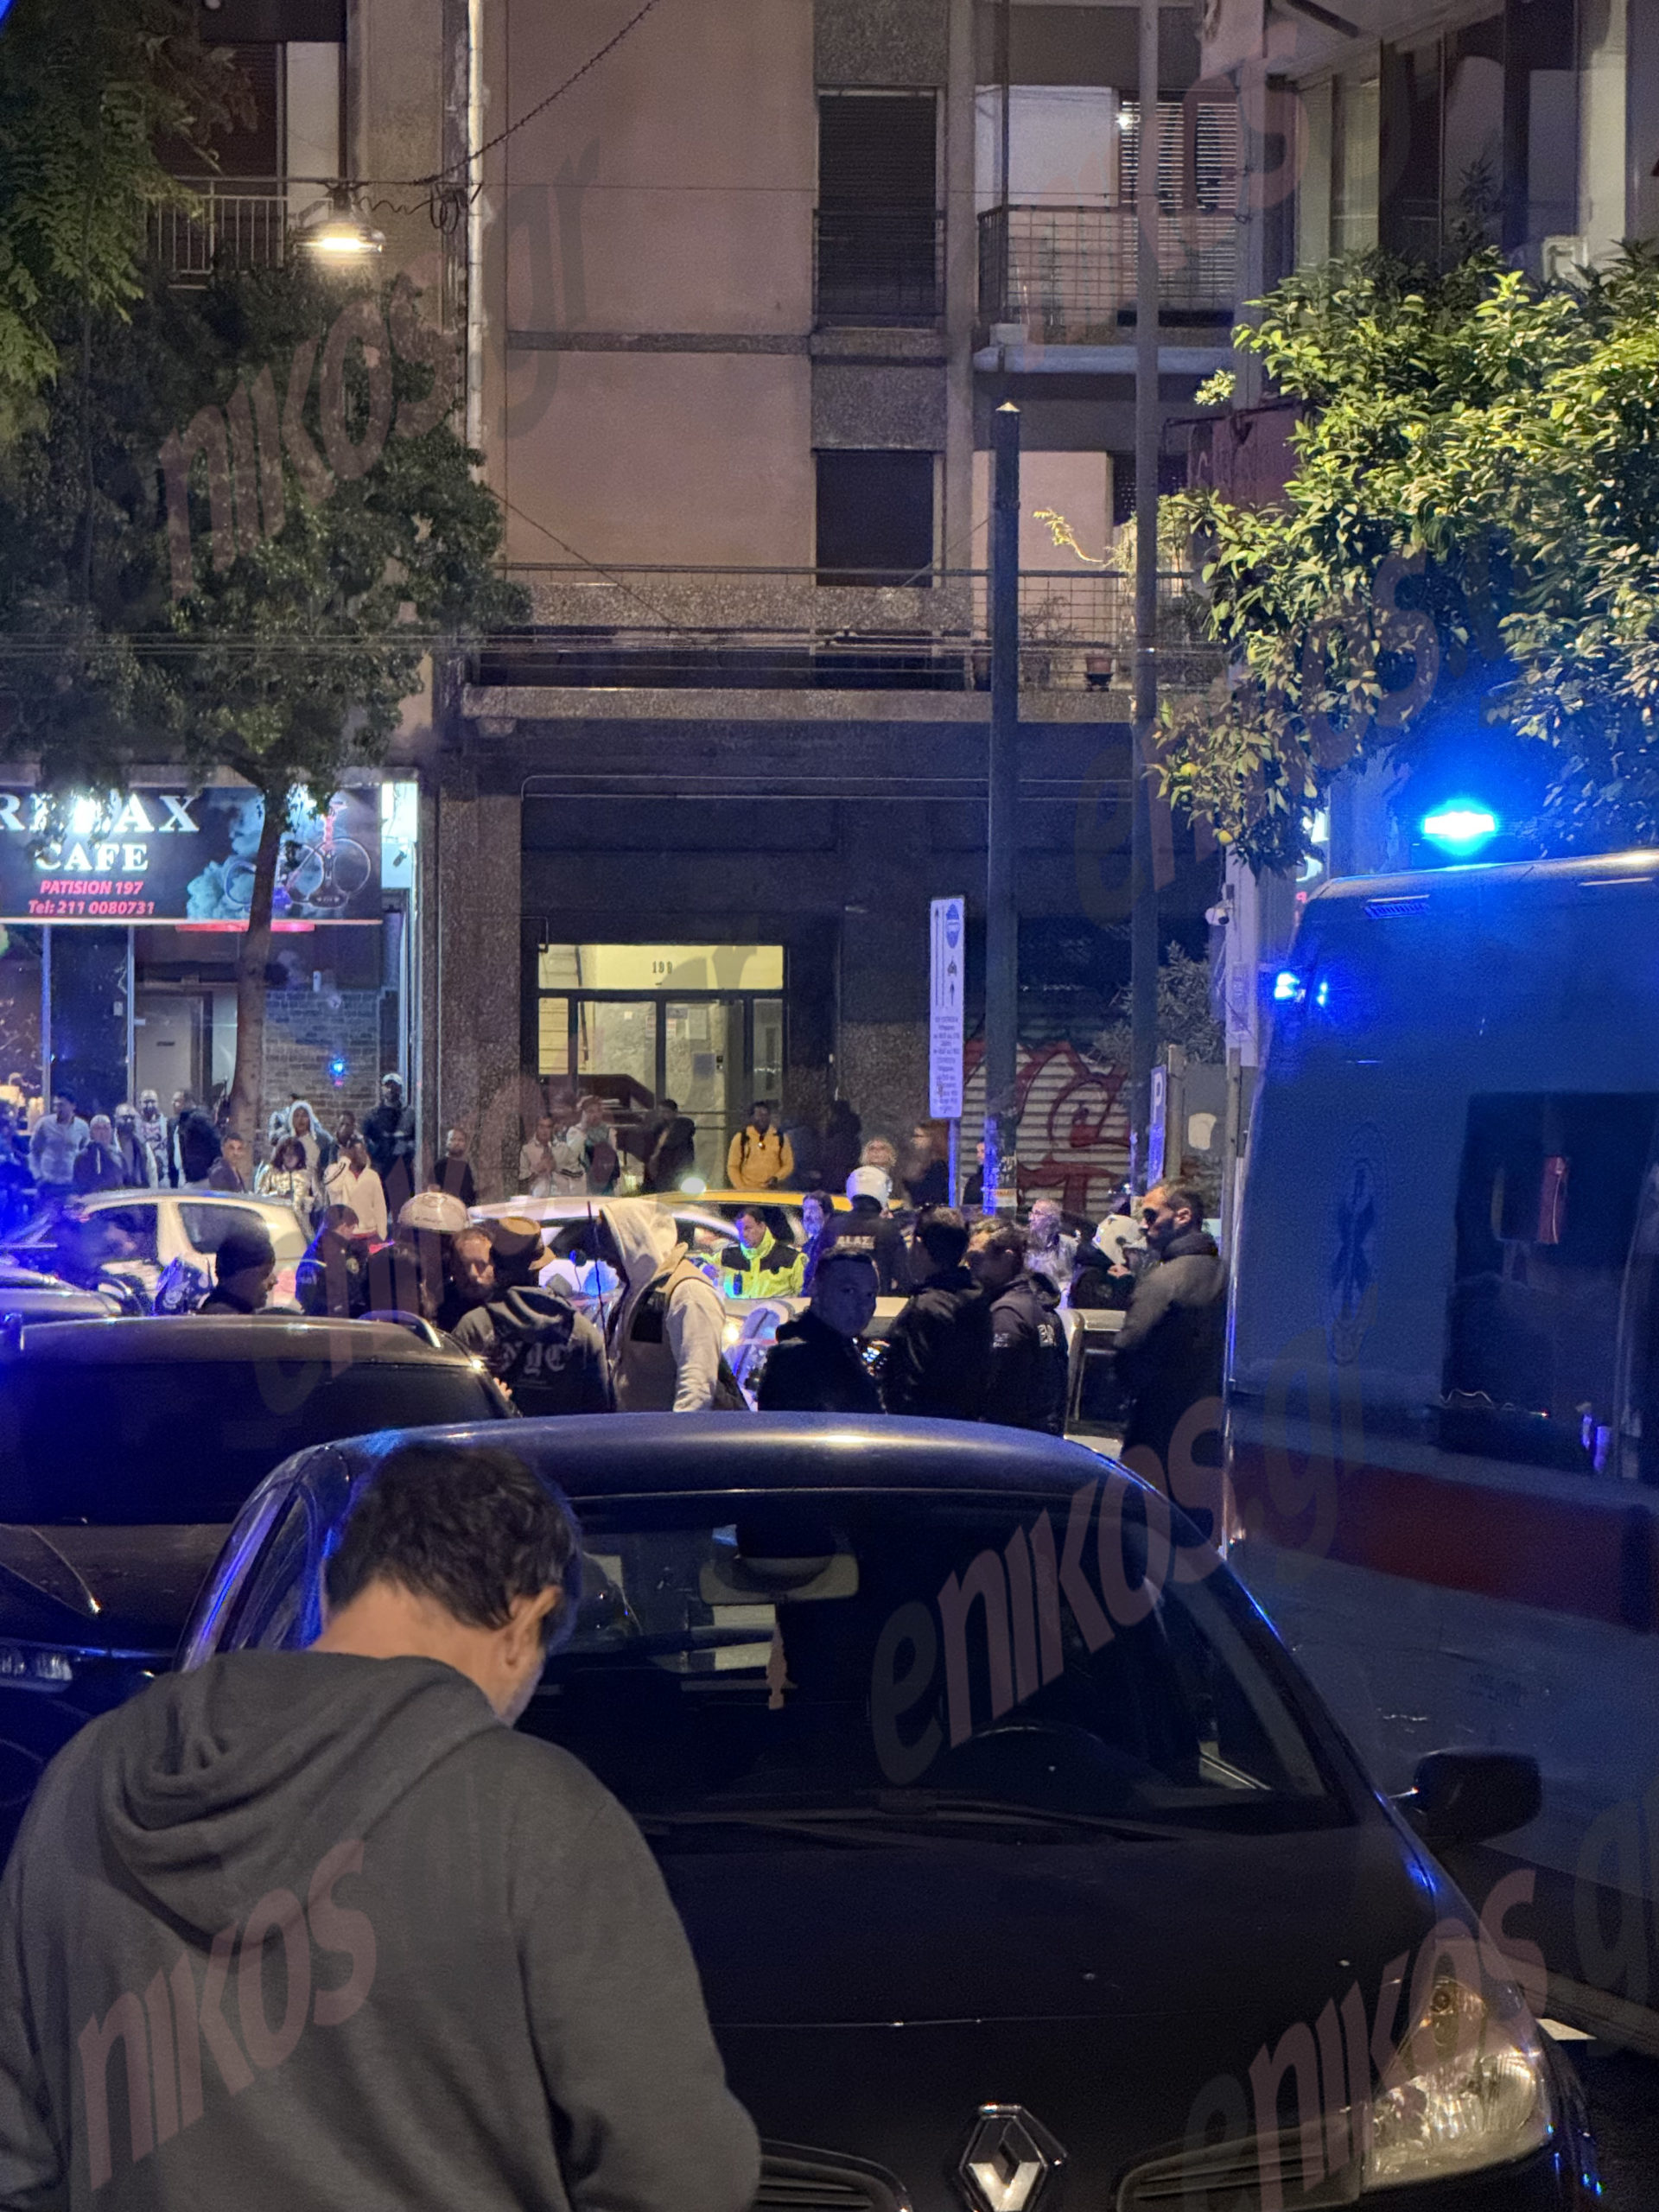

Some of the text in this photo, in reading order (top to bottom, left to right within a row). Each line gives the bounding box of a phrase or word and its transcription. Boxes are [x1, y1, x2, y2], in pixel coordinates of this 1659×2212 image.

[35, 842, 149, 872] CAFE
[40, 880, 144, 895] PATISION 197
[28, 899, 155, 915] Tel: 211 0080731
